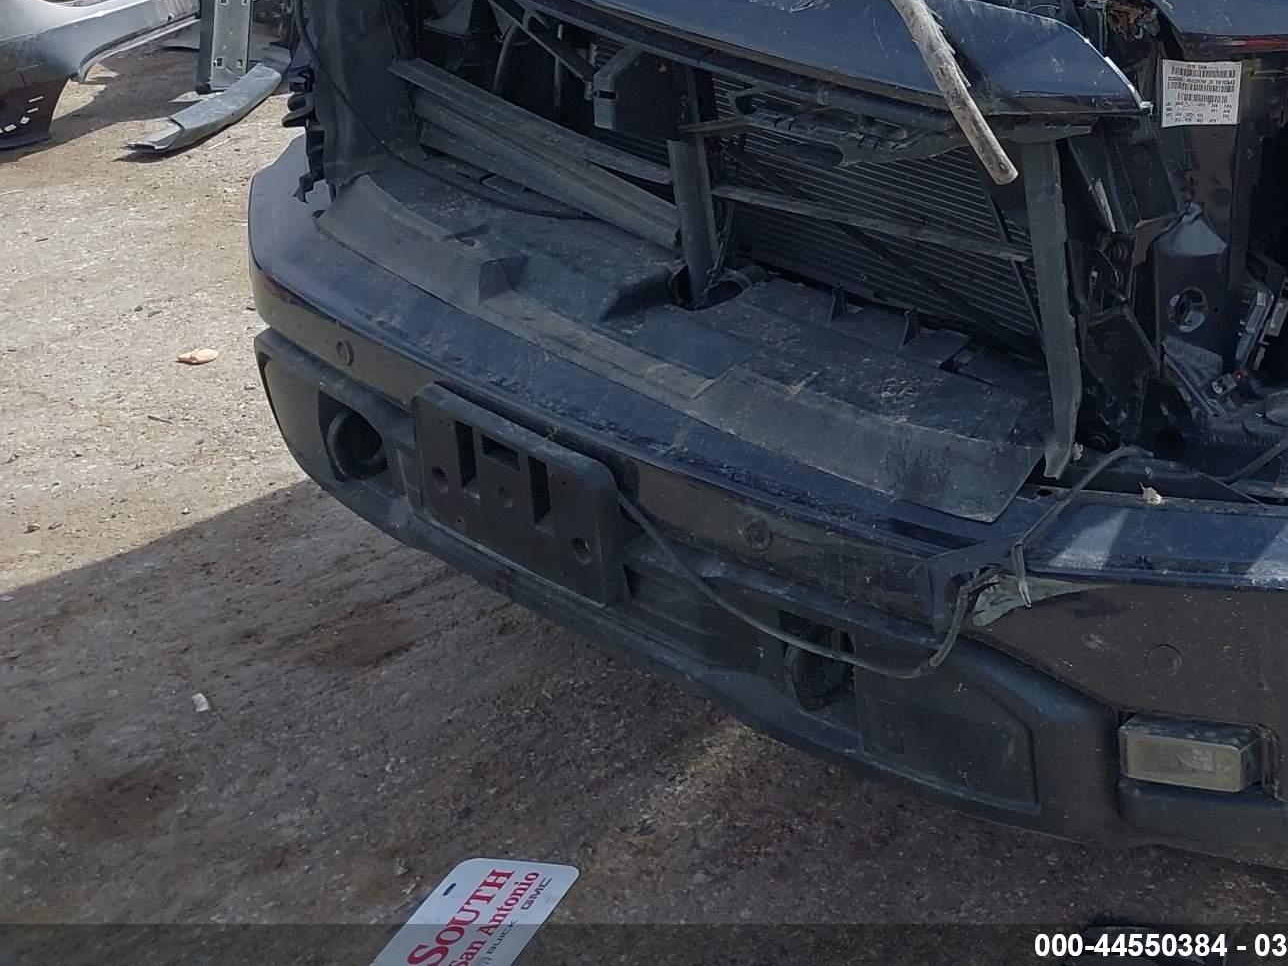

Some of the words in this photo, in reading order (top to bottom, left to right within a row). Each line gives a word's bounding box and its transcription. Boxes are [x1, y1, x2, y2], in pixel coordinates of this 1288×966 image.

[407, 868, 516, 966] SOUTH
[476, 871, 540, 938] Antonio
[486, 917, 520, 956] BUICK
[520, 876, 553, 911] GMC
